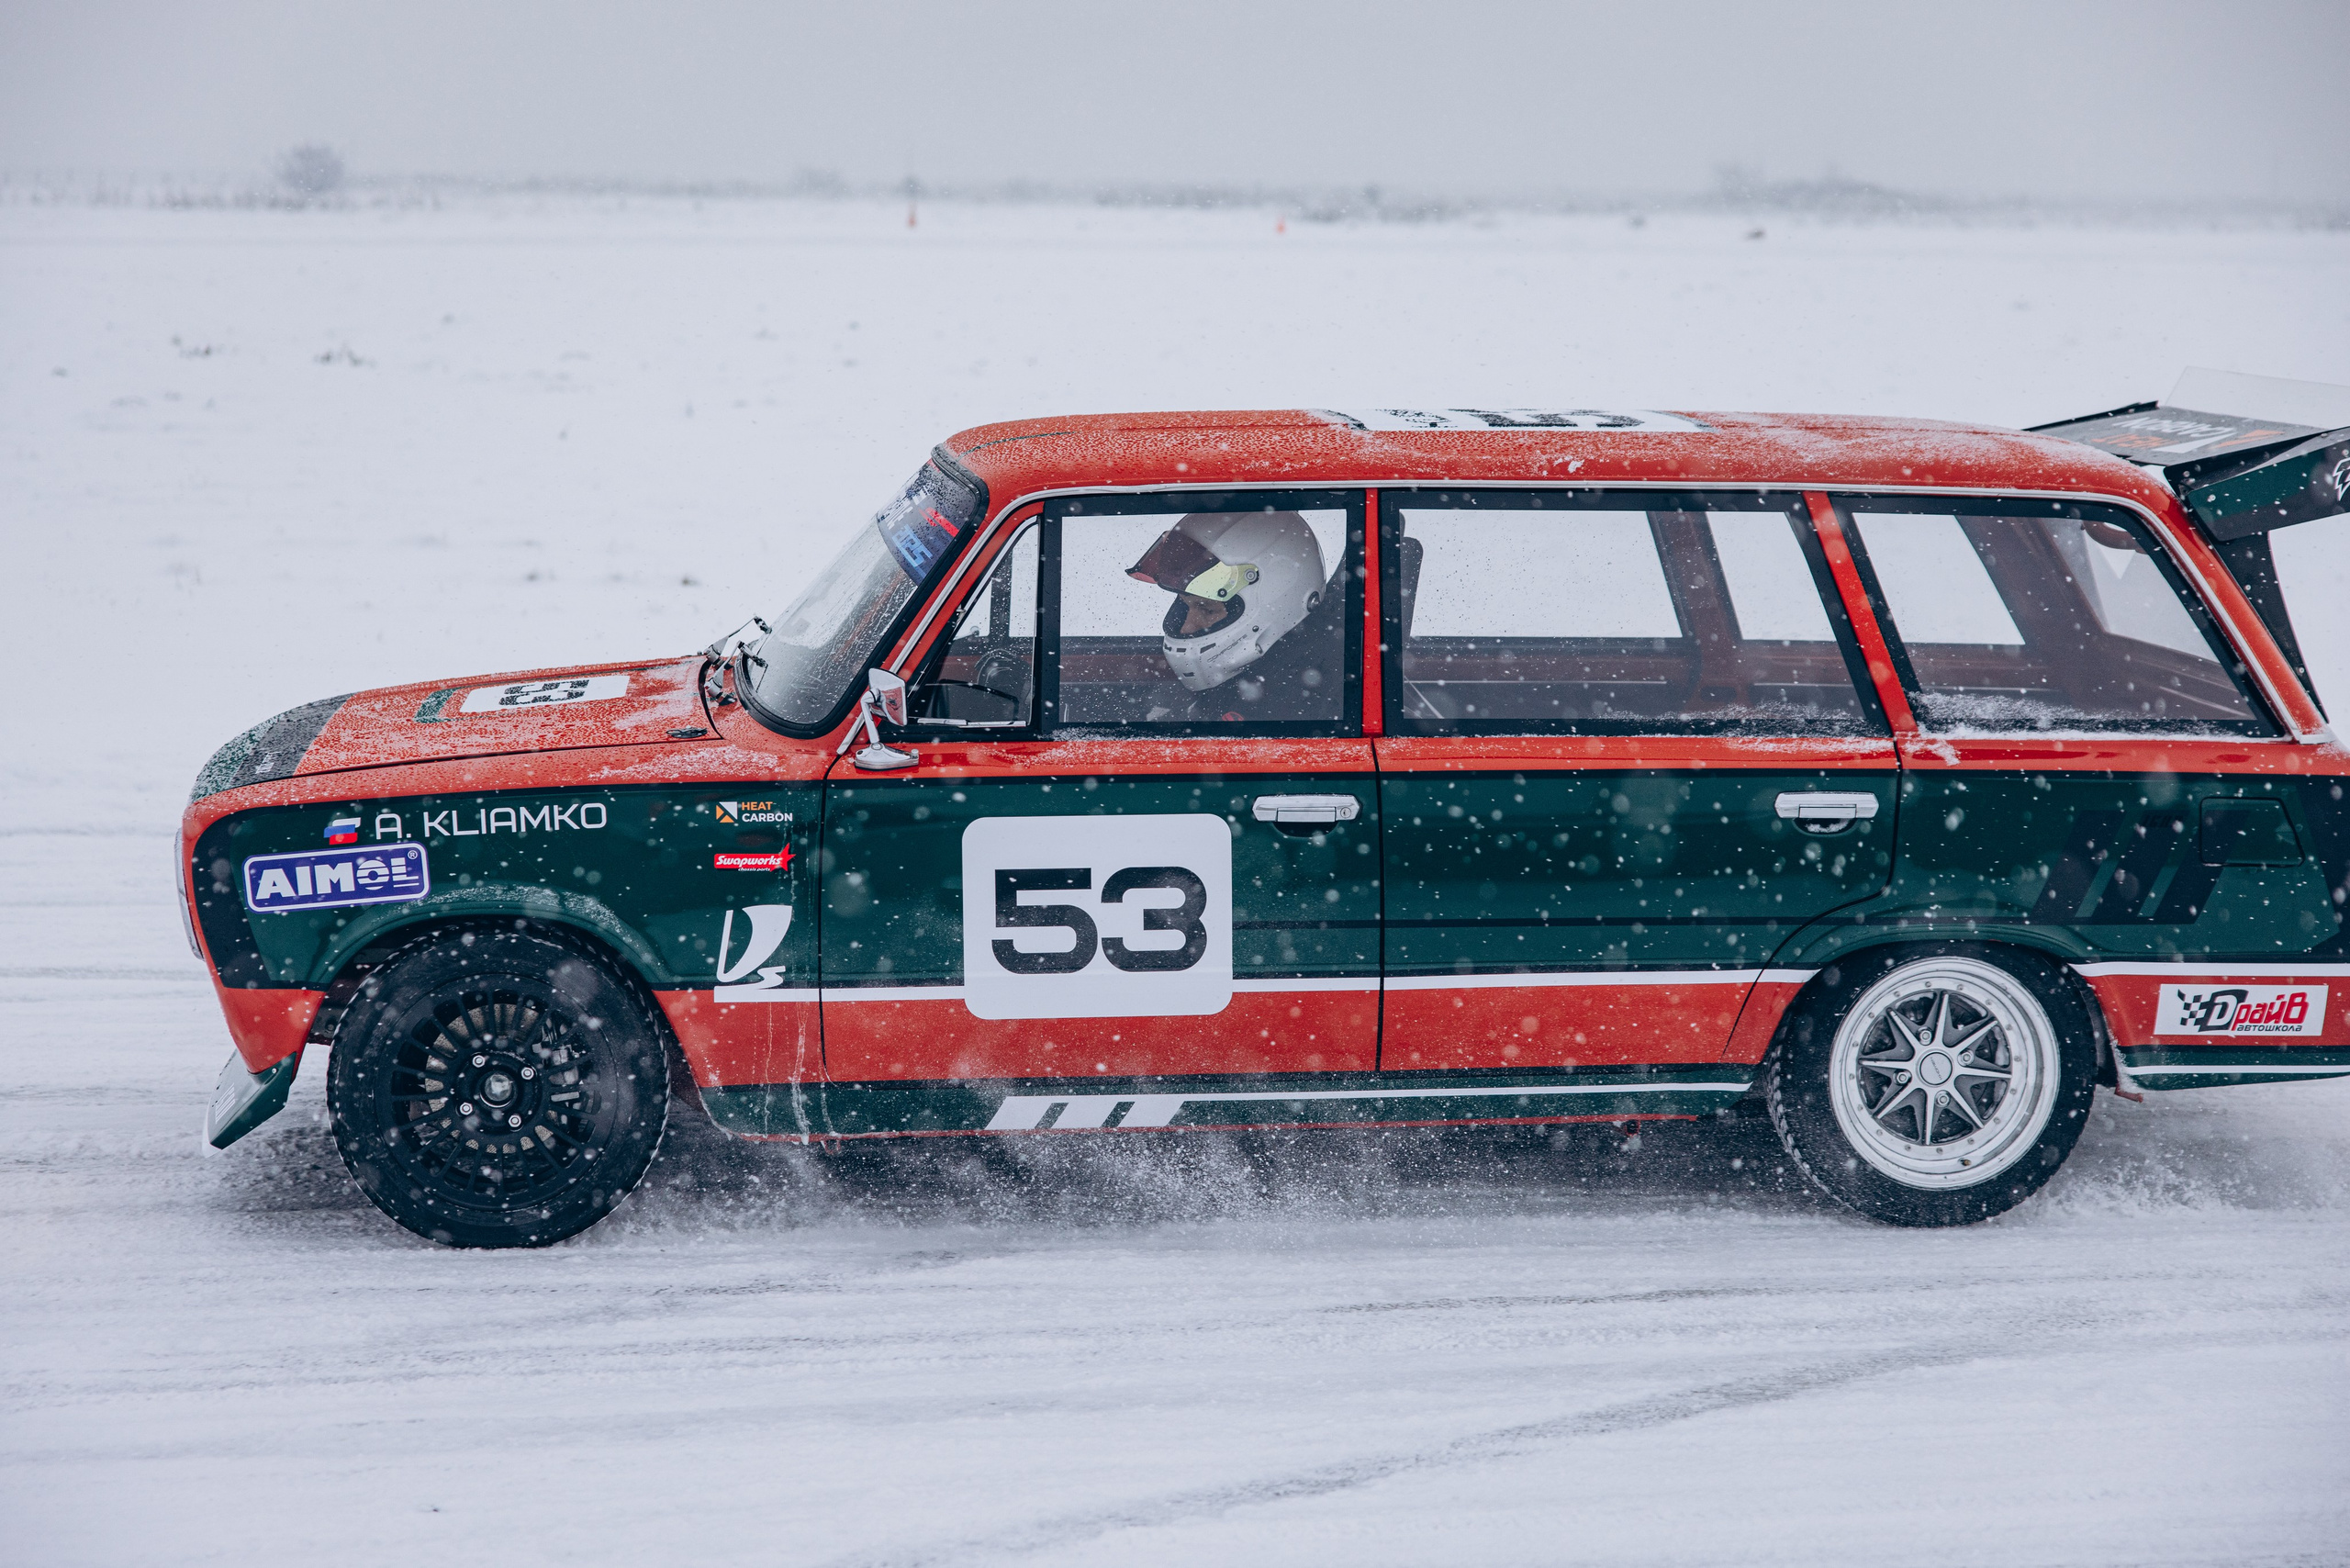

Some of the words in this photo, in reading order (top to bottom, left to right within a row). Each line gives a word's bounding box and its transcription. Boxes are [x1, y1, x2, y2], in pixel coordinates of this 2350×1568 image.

[741, 801, 774, 811] HEAT
[375, 812, 412, 840] A.
[423, 801, 608, 838] KLIAMKO
[741, 812, 793, 823] CARBON
[716, 855, 783, 868] Swapworks
[255, 857, 420, 900] AIMOL
[990, 866, 1208, 975] 53
[2236, 1024, 2303, 1033] автошкола
